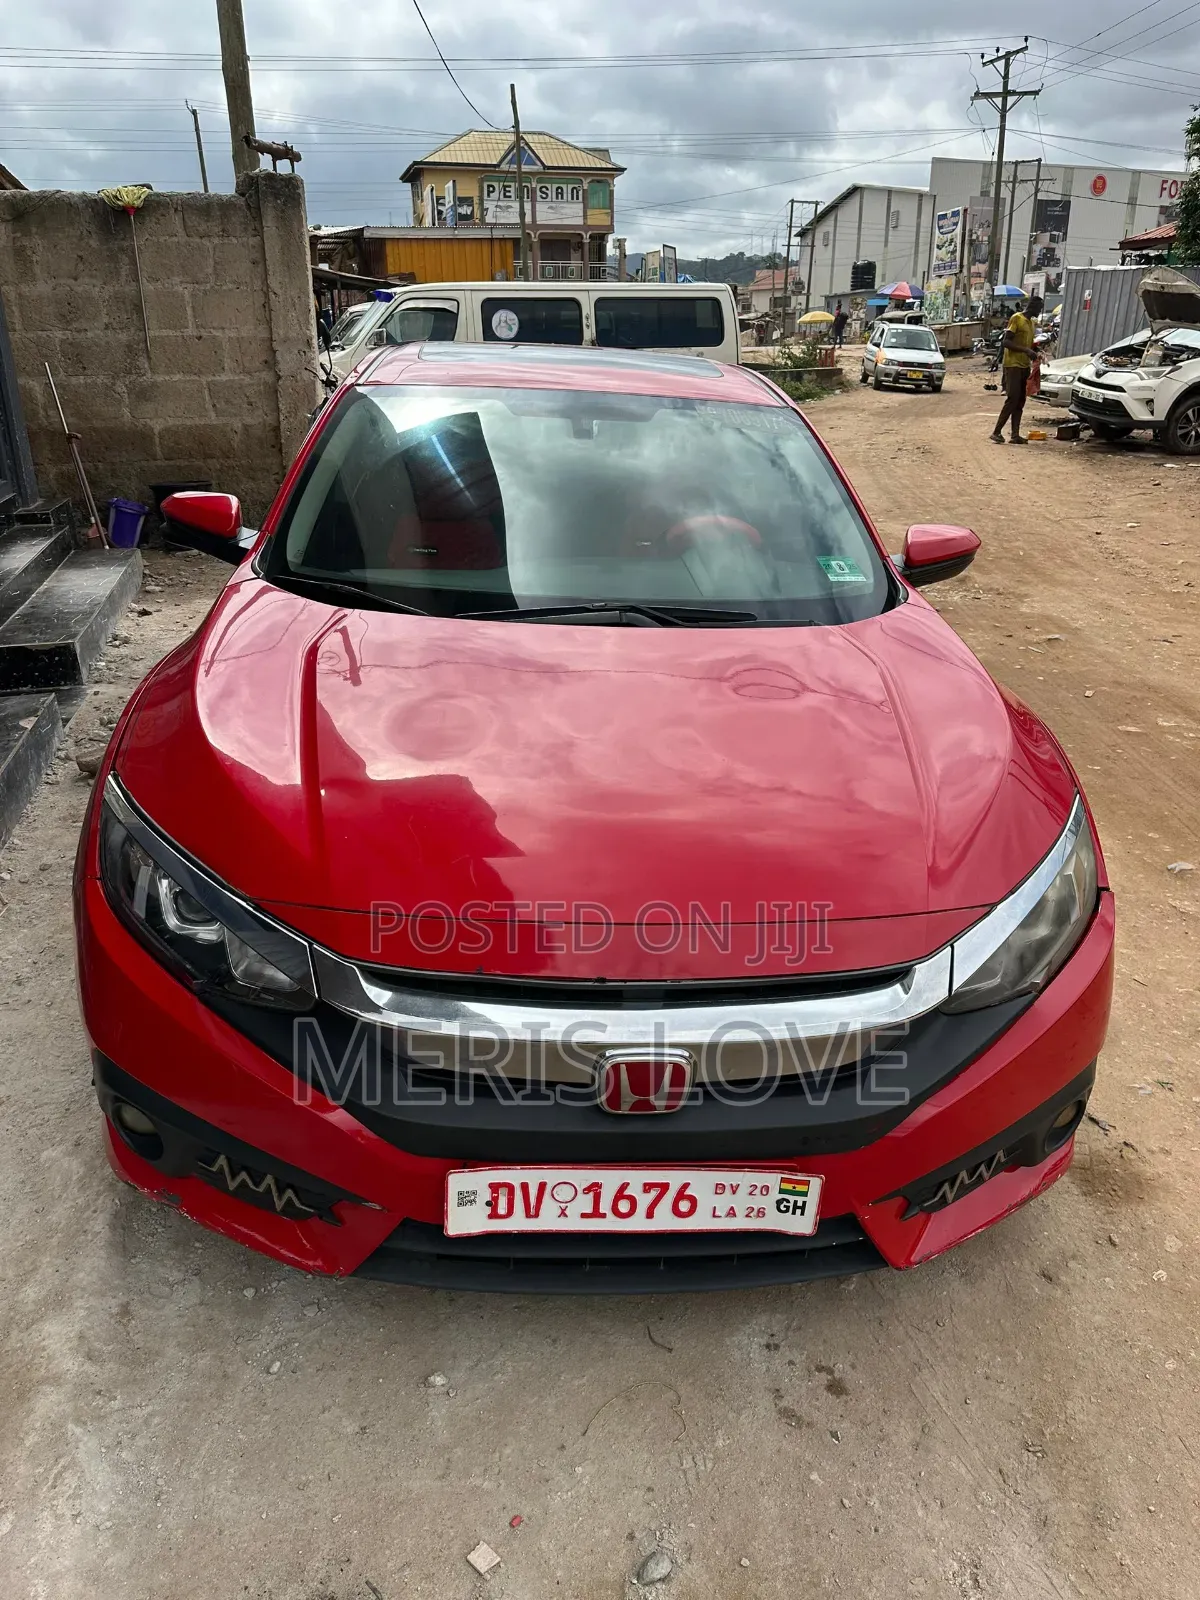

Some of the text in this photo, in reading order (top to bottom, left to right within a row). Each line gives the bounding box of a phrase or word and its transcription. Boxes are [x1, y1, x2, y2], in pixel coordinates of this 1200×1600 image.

[714, 1182, 770, 1197] DV 20
[487, 1181, 698, 1220] DV 1676
[776, 1197, 807, 1217] GH
[712, 1205, 767, 1219] LA 26
